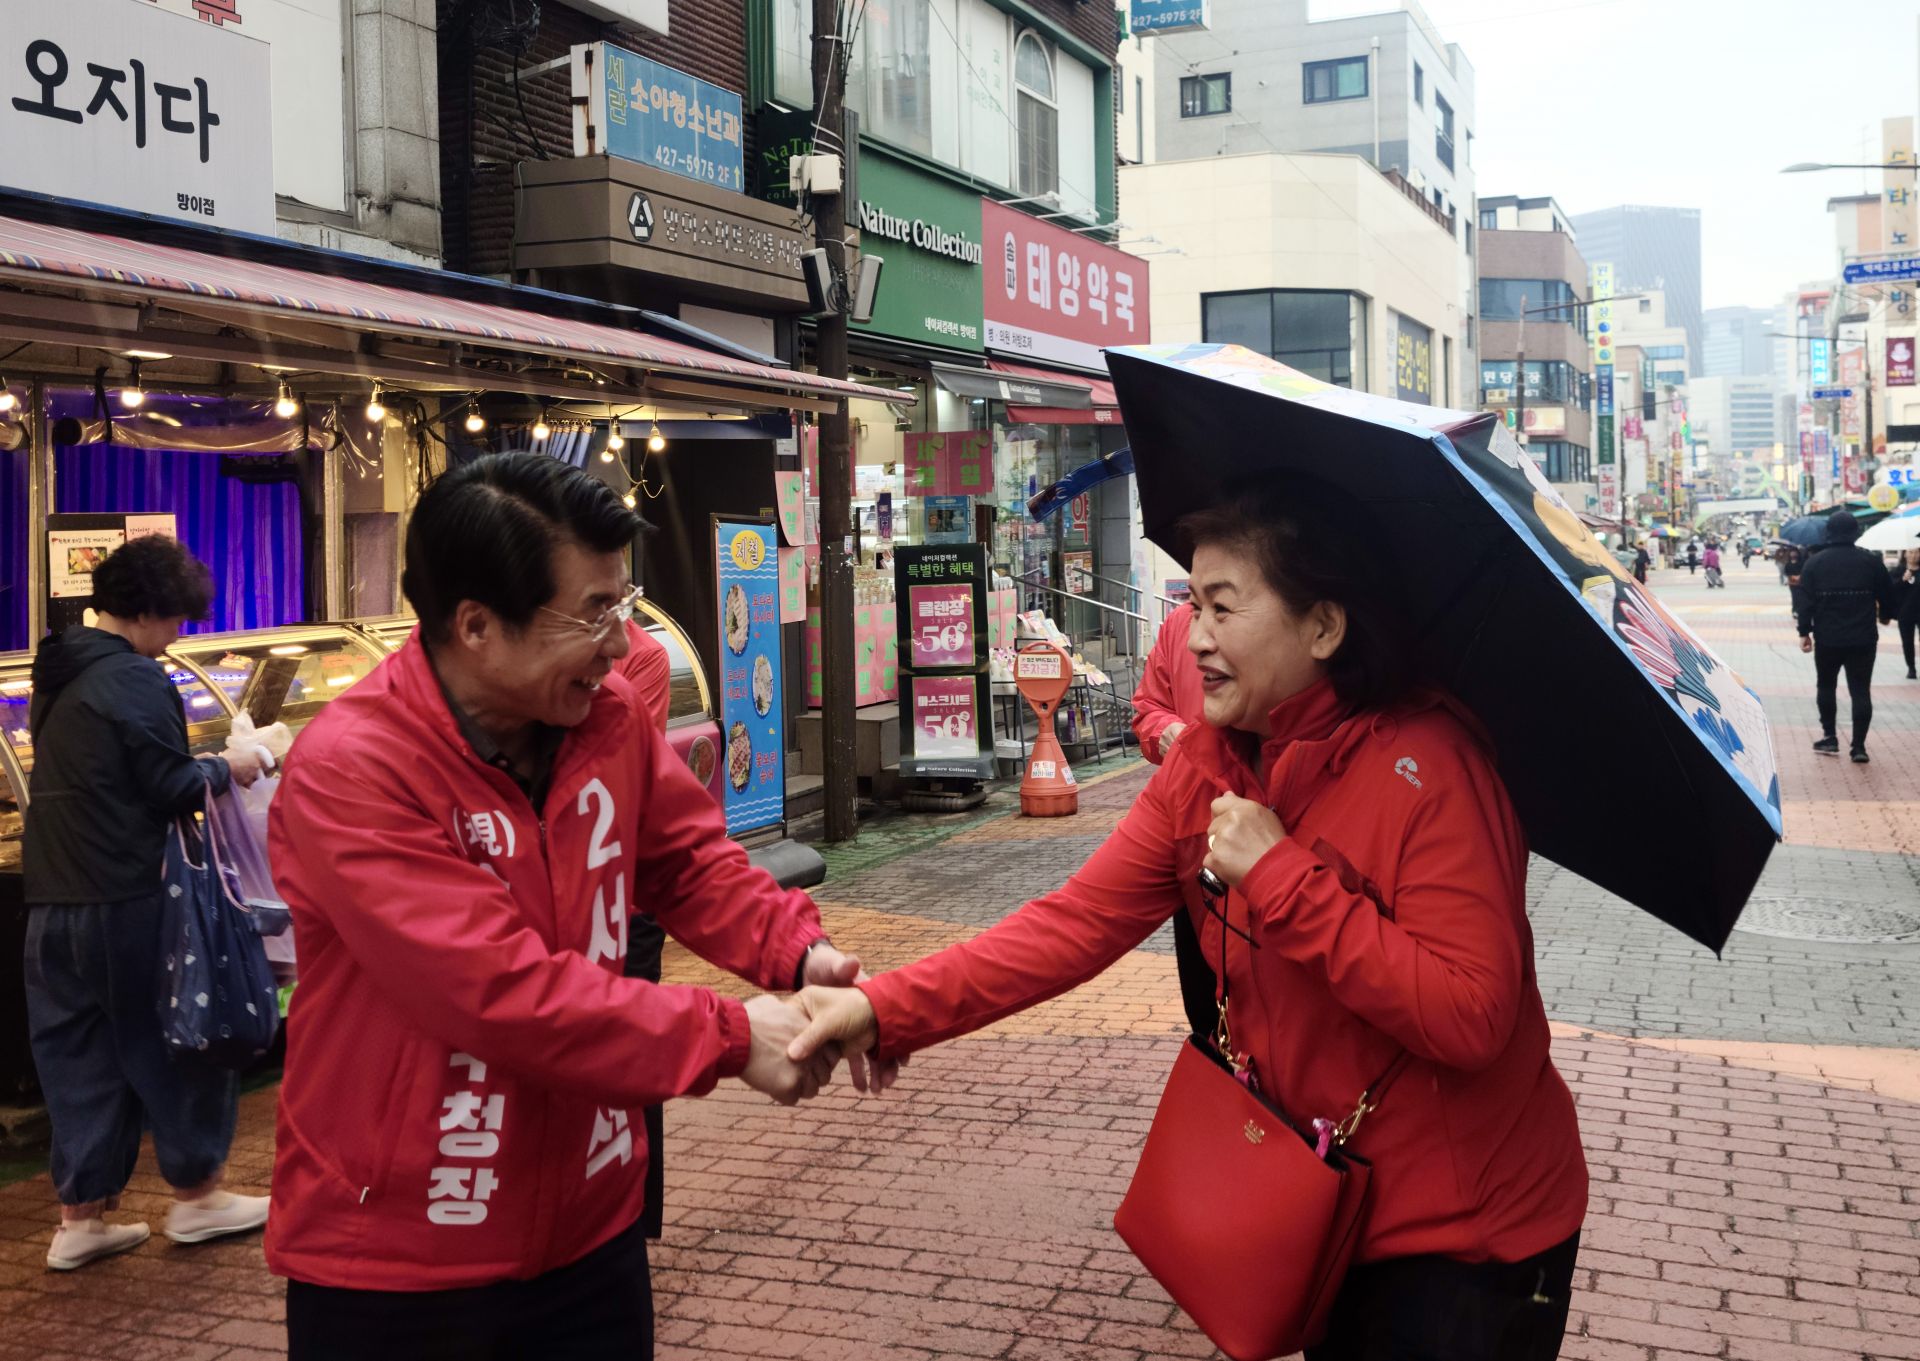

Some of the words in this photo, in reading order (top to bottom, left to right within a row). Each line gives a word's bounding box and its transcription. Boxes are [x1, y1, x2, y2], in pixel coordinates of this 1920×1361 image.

[1132, 10, 1186, 26] 427-5975
[1189, 8, 1202, 20] 2F
[11, 39, 221, 164] 오지다
[607, 54, 627, 126] 세란
[630, 77, 740, 148] 소아청소년과
[655, 144, 715, 180] 427-5975
[717, 165, 730, 184] 2F
[176, 192, 215, 216] 방이점
[858, 199, 911, 245] Nature
[912, 218, 983, 266] Collection
[1026, 242, 1135, 333] 태양약국
[925, 316, 959, 337] 네이처컬렉션
[735, 536, 759, 566] 제철
[921, 553, 958, 562] 네이처컬렉션
[906, 563, 946, 578] 특별한
[949, 561, 975, 576] 혜택
[918, 599, 966, 617] 클렌징
[1020, 663, 1060, 675] 주차금지
[917, 694, 971, 707] 마스크시트
[577, 777, 622, 871] 2
